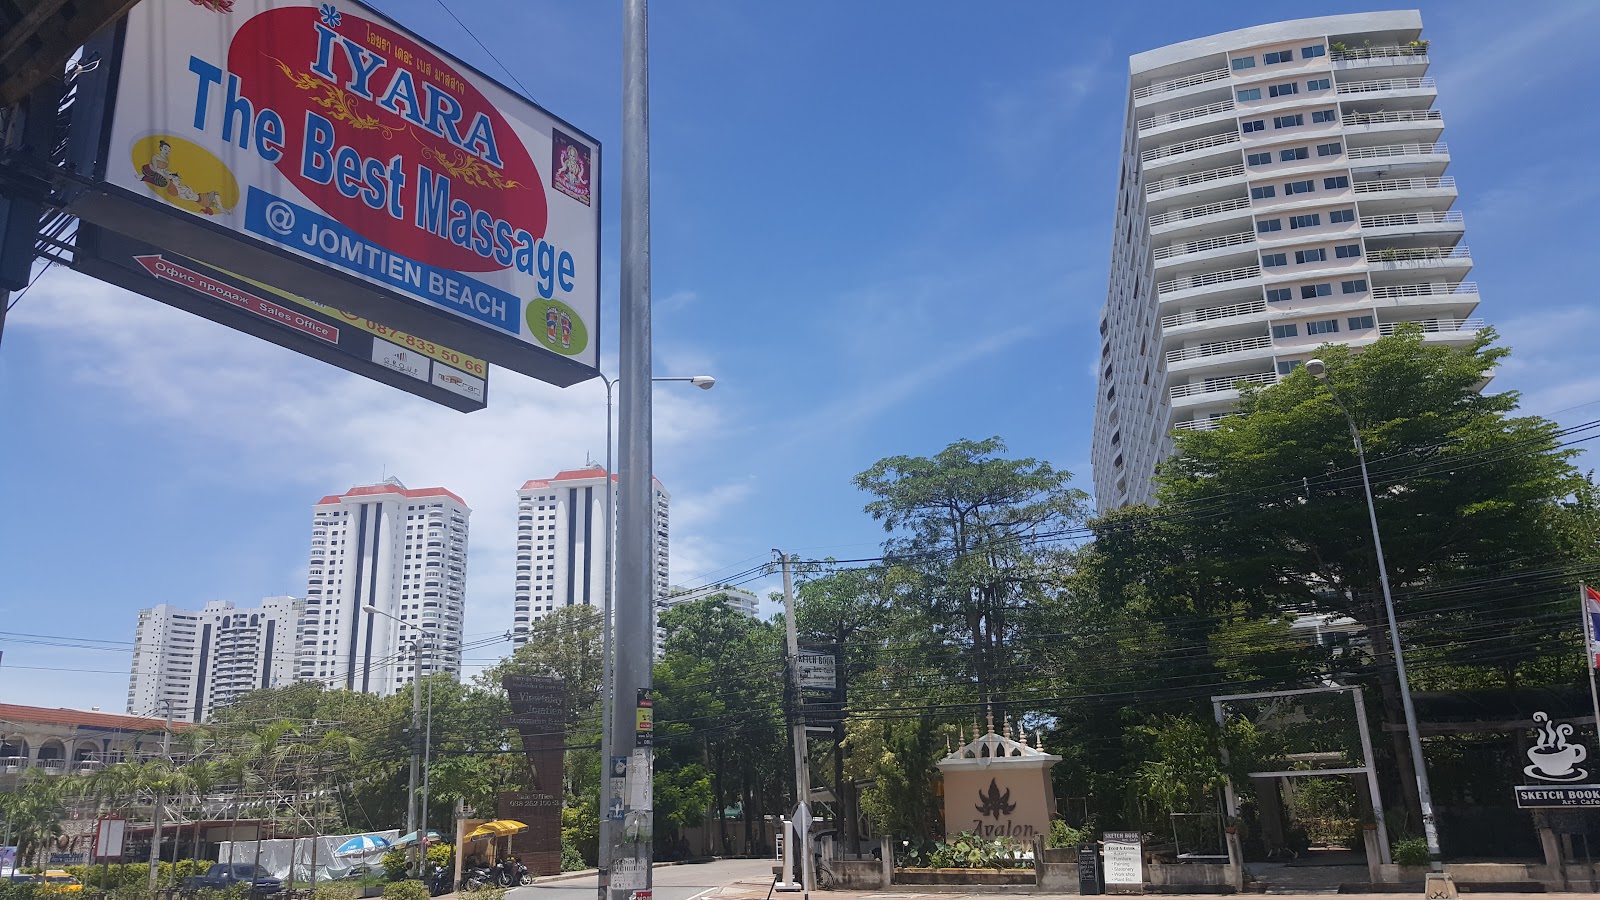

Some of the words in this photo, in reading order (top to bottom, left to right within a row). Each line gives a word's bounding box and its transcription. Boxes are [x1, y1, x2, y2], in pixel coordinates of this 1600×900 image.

[395, 45, 413, 66] เดอะ
[416, 58, 432, 77] เบส
[310, 21, 503, 169] IYARA
[189, 55, 285, 164] The
[300, 109, 406, 220] Best
[415, 164, 576, 299] Massage
[265, 201, 296, 235] @
[302, 223, 421, 288] JOMTIEN
[428, 270, 506, 321] BEACH
[155, 262, 195, 283] Офис
[200, 280, 249, 305] продаж
[259, 303, 292, 321] Sales
[295, 317, 329, 336] Office
[366, 320, 436, 355] 087-833
[441, 349, 460, 364] 50
[465, 360, 483, 374] 66
[798, 655, 817, 664] KETCH
[1521, 791, 1564, 800] SKETCH
[1568, 790, 1600, 799] BOOK
[973, 819, 1033, 837] Avalon
